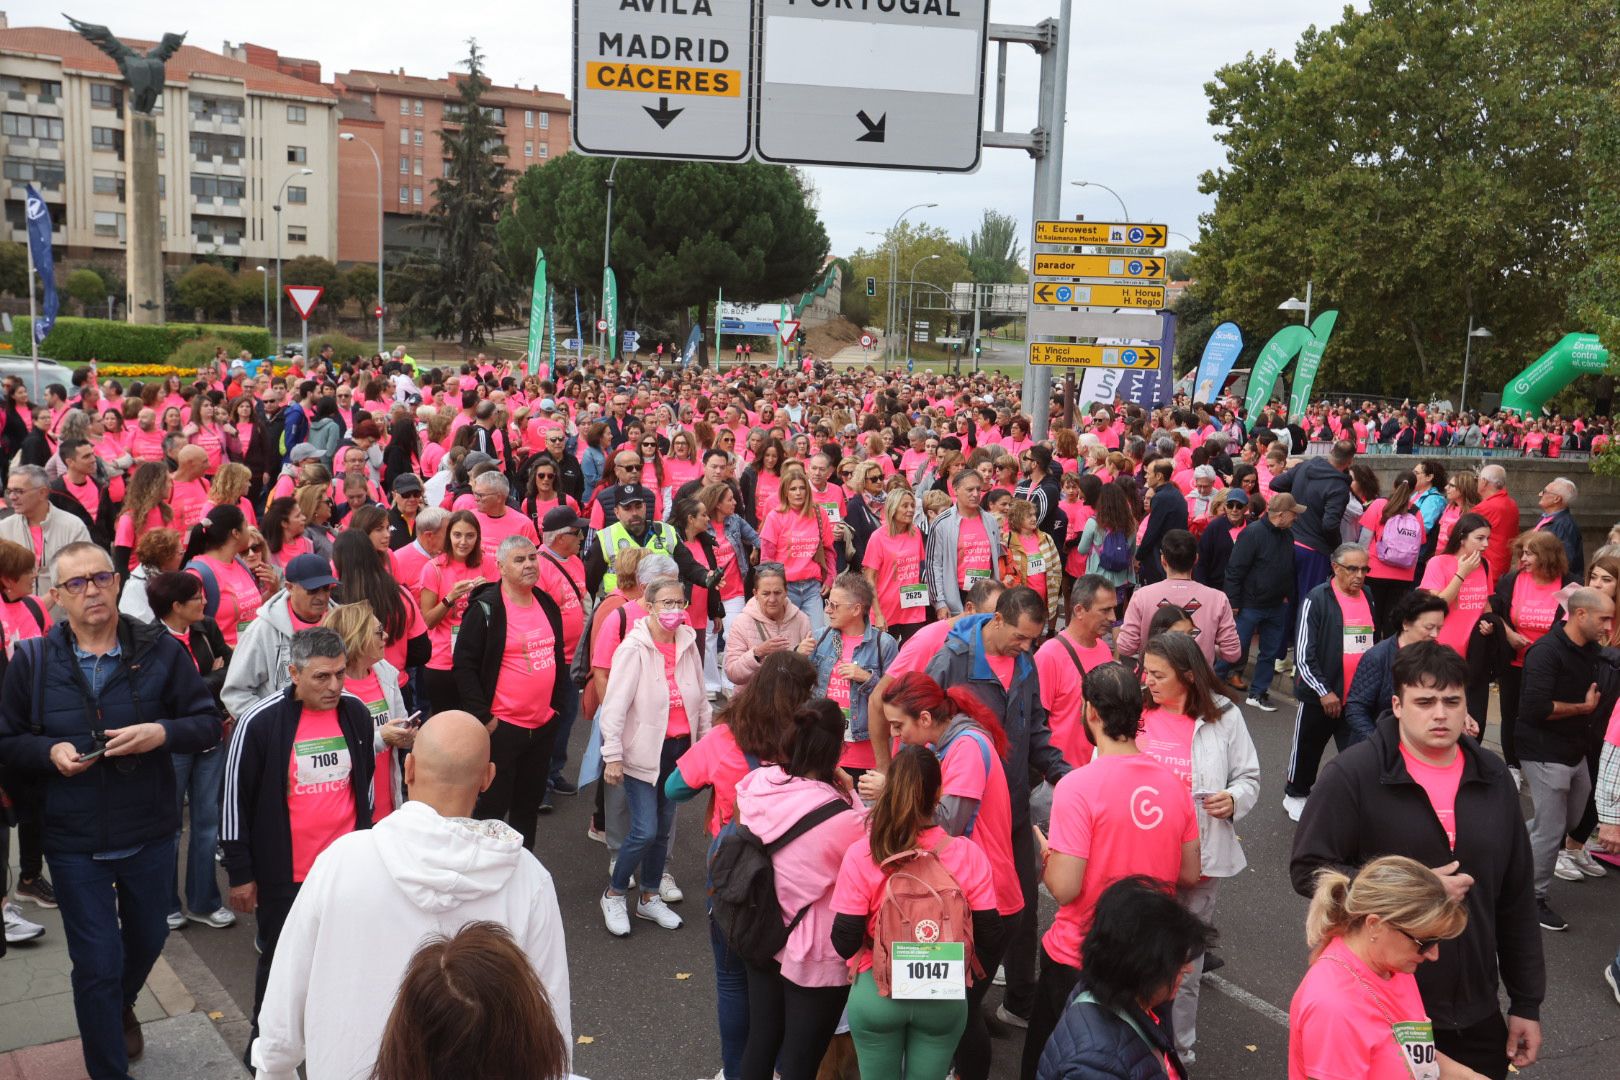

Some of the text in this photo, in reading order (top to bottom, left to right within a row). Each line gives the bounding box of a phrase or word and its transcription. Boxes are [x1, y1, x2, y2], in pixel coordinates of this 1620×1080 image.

[598, 31, 730, 64] MADRID
[597, 64, 729, 93] CÁCERES
[1053, 225, 1097, 234] Eurowest
[1038, 260, 1075, 271] parador
[1135, 289, 1162, 298] Horus
[1136, 298, 1161, 307] Regio
[1045, 346, 1070, 355] Vincci
[1055, 356, 1091, 364] Romano
[1571, 351, 1598, 360] contra
[1396, 527, 1417, 538] VANS
[906, 592, 922, 600] 2625
[527, 641, 538, 650] En
[311, 752, 339, 769] 7108
[907, 962, 949, 979] 10147
